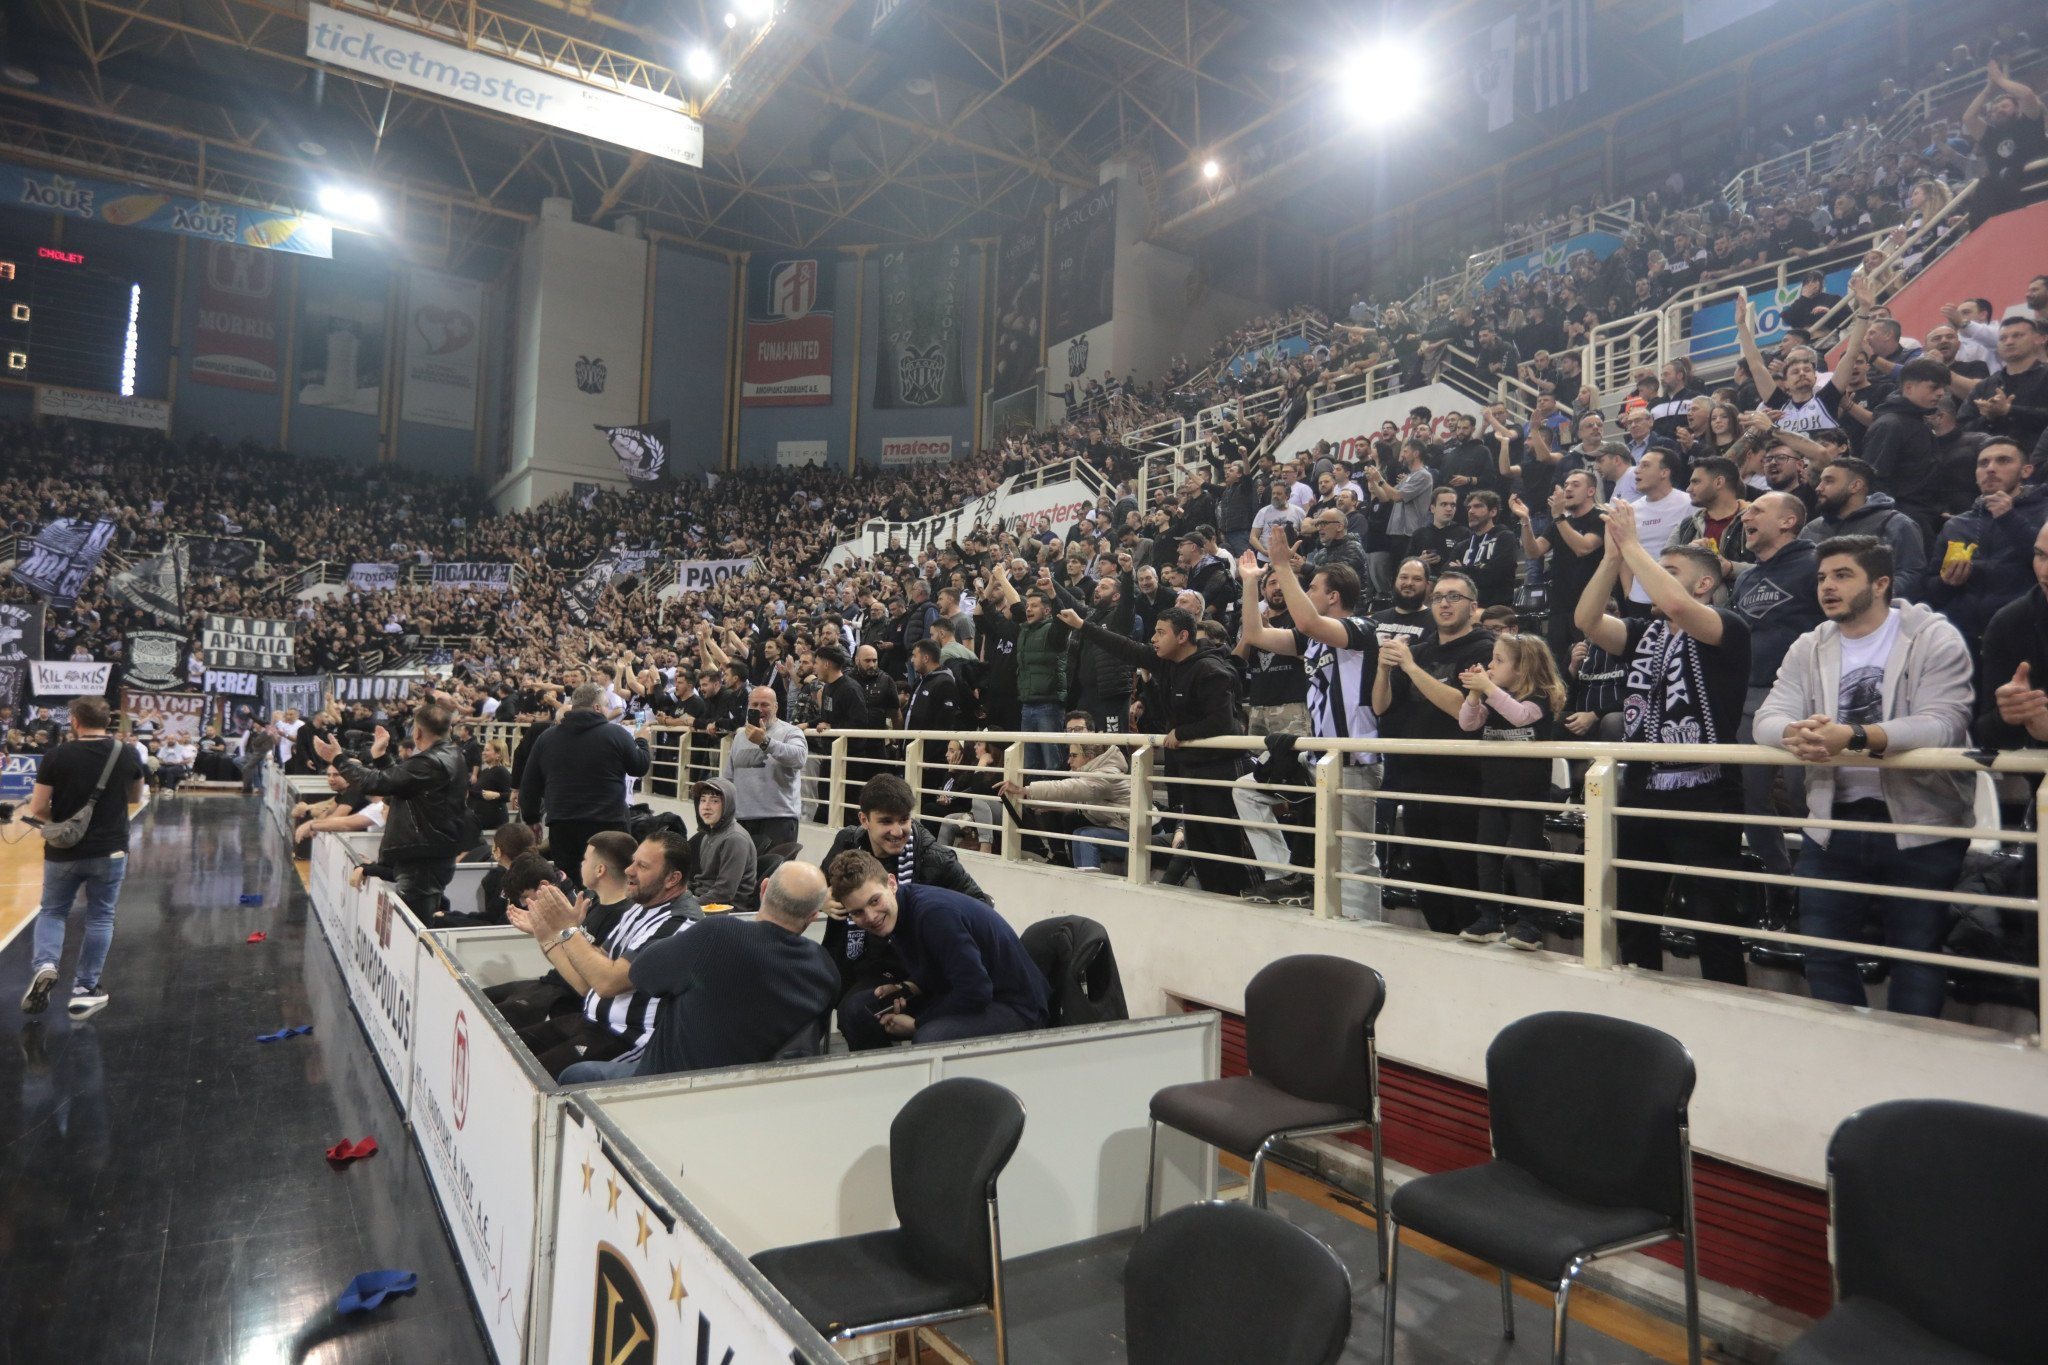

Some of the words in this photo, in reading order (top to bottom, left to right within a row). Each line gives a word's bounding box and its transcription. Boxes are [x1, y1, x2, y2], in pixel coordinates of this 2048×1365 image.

[314, 21, 553, 111] ticketmaster
[37, 248, 84, 264] CHOLET
[199, 308, 275, 339] MORRIS
[758, 340, 820, 361] FUNAI-UNITED
[883, 441, 951, 456] mateco
[975, 489, 997, 516] 28
[687, 565, 746, 587] PAOK
[210, 632, 288, 654] ΑΡΙΔΑΙΑ
[204, 670, 258, 697] PEREA
[355, 924, 411, 1052] SIDIROPOULOS
